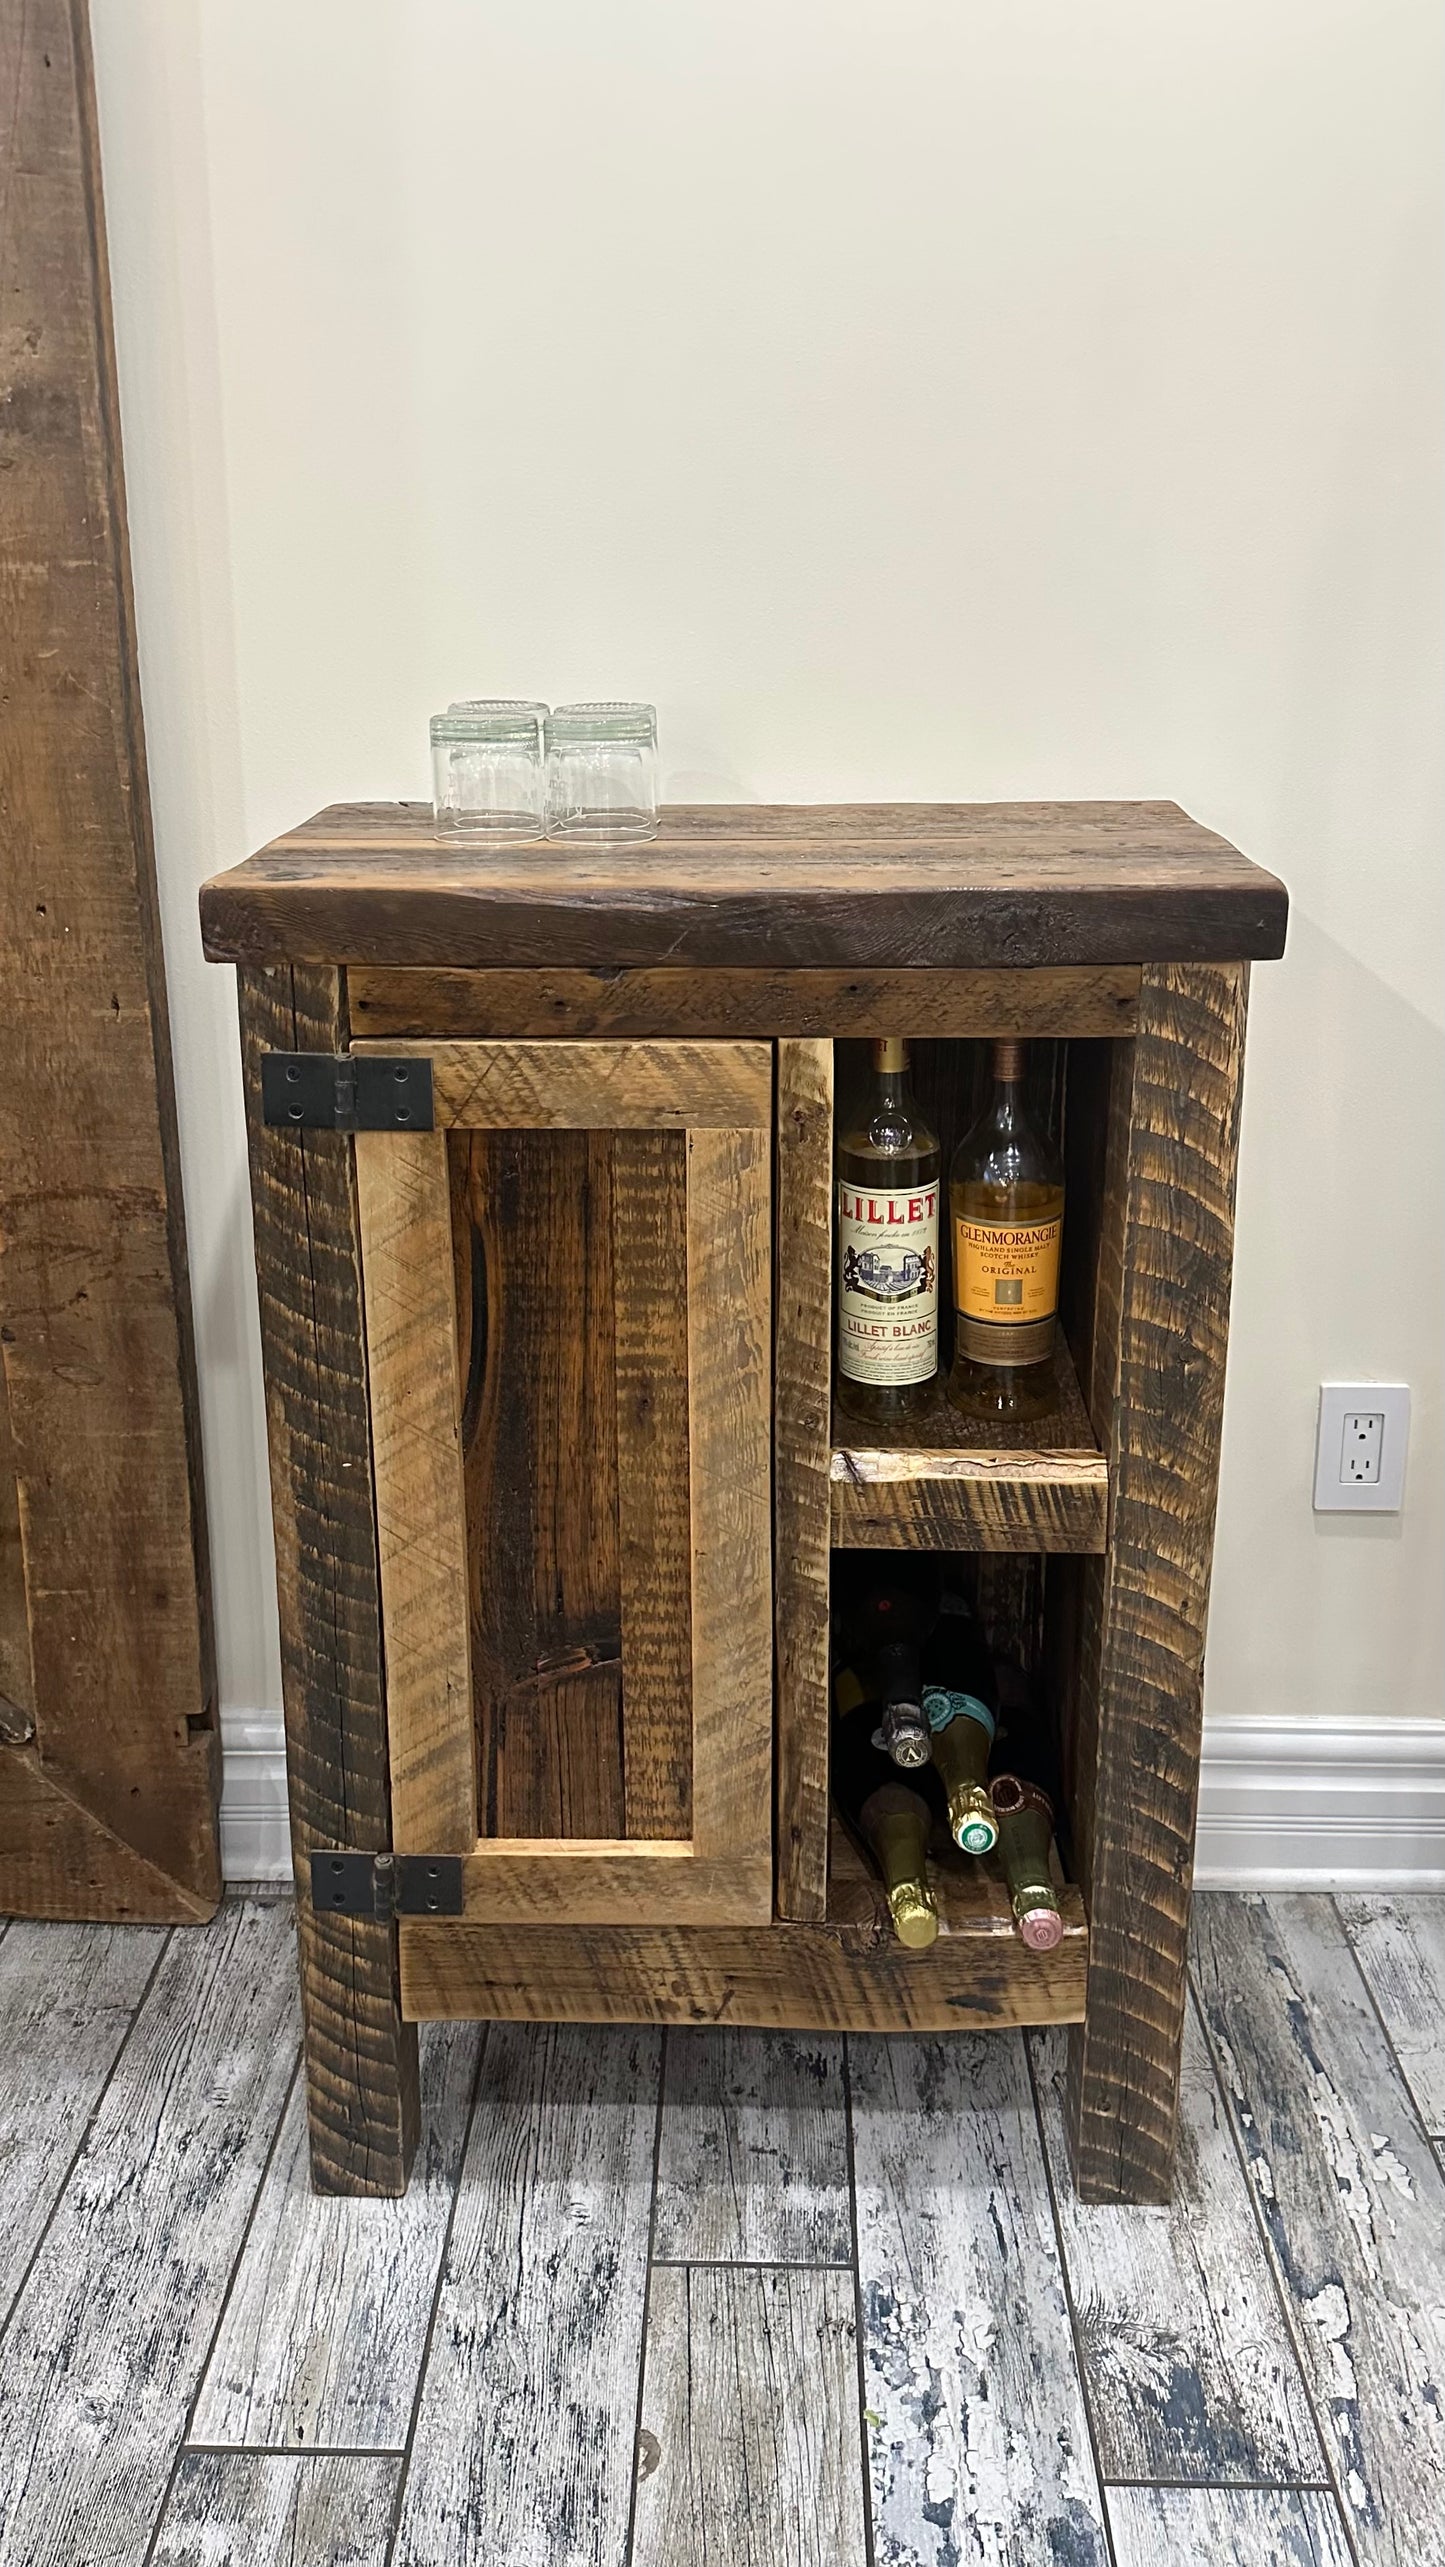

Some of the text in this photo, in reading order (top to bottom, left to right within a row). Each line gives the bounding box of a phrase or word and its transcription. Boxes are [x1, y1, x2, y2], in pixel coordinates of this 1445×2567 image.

[843, 1191, 936, 1225] LILLET
[960, 1224, 1057, 1246] GLENMORANGIE
[968, 1242, 1005, 1253] HIGHLAND
[1034, 1242, 1051, 1251] MALT
[980, 1251, 1039, 1260] SCOTCH WHISKY
[981, 1265, 1037, 1275] ORIGINAL
[847, 1319, 931, 1337] LILLET BLANC
